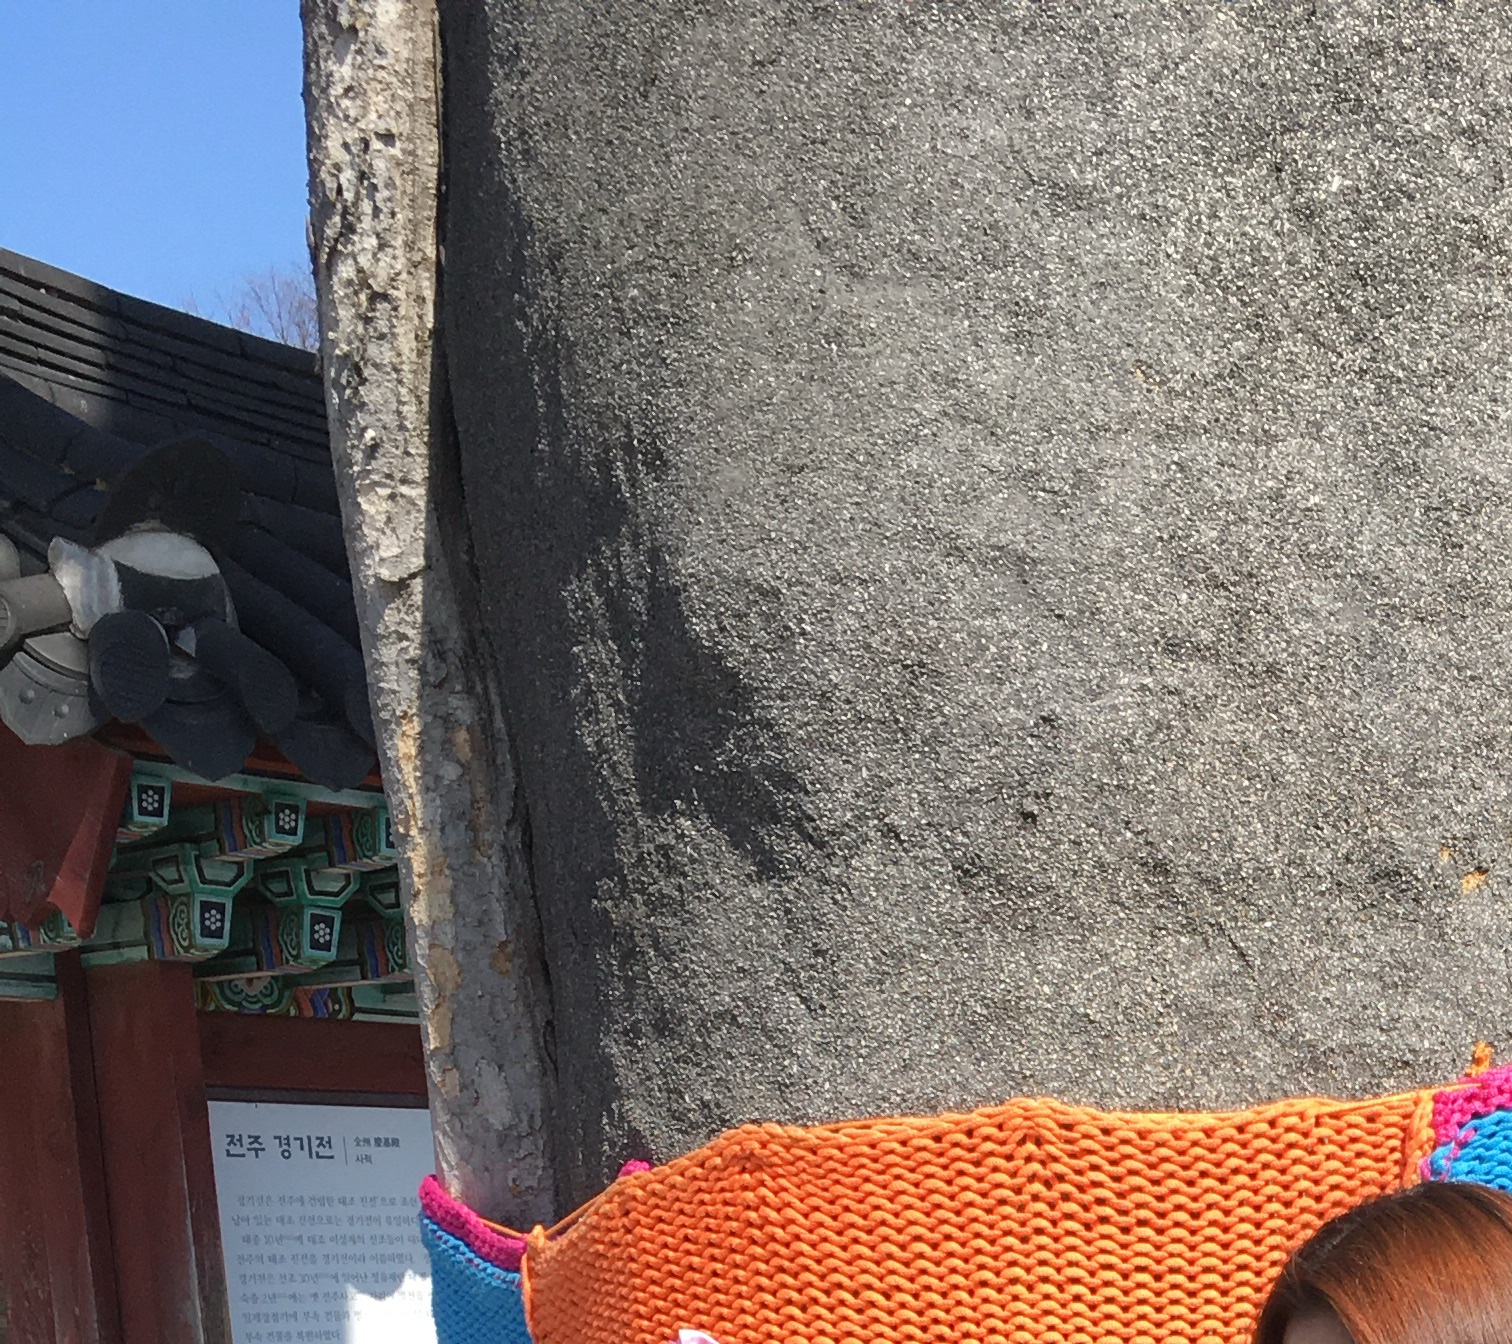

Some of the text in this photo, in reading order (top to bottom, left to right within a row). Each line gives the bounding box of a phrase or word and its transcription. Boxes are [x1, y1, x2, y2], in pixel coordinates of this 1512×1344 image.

[225, 1133, 335, 1160] 전주 경기전
[355, 1153, 373, 1165] 사적
